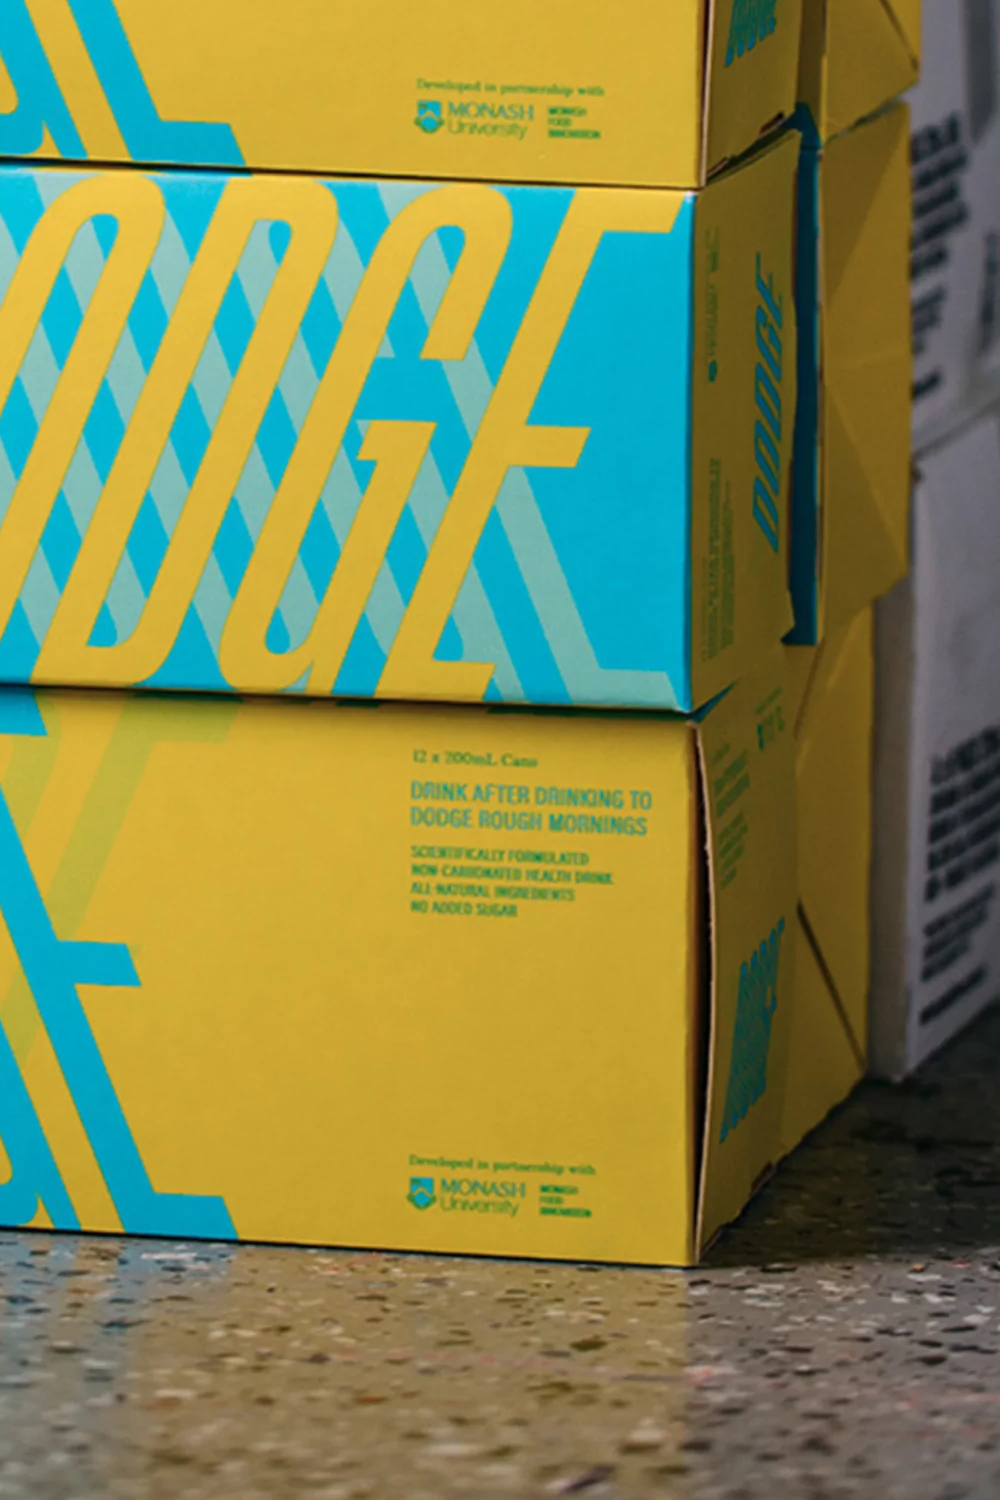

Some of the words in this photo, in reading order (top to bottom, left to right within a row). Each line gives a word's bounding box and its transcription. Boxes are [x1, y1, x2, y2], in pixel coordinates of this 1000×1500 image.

[449, 101, 534, 120] MONASH
[449, 119, 528, 140] University
[411, 781, 468, 801] DRINK
[473, 783, 529, 804] AFTER
[535, 786, 624, 809] DRINKING
[630, 790, 652, 810] TO
[410, 806, 472, 827] DODGE
[479, 809, 542, 831] ROUGH
[549, 814, 647, 836] MORNINGS
[441, 1179, 526, 1198] MONASH
[440, 1196, 519, 1218] University
